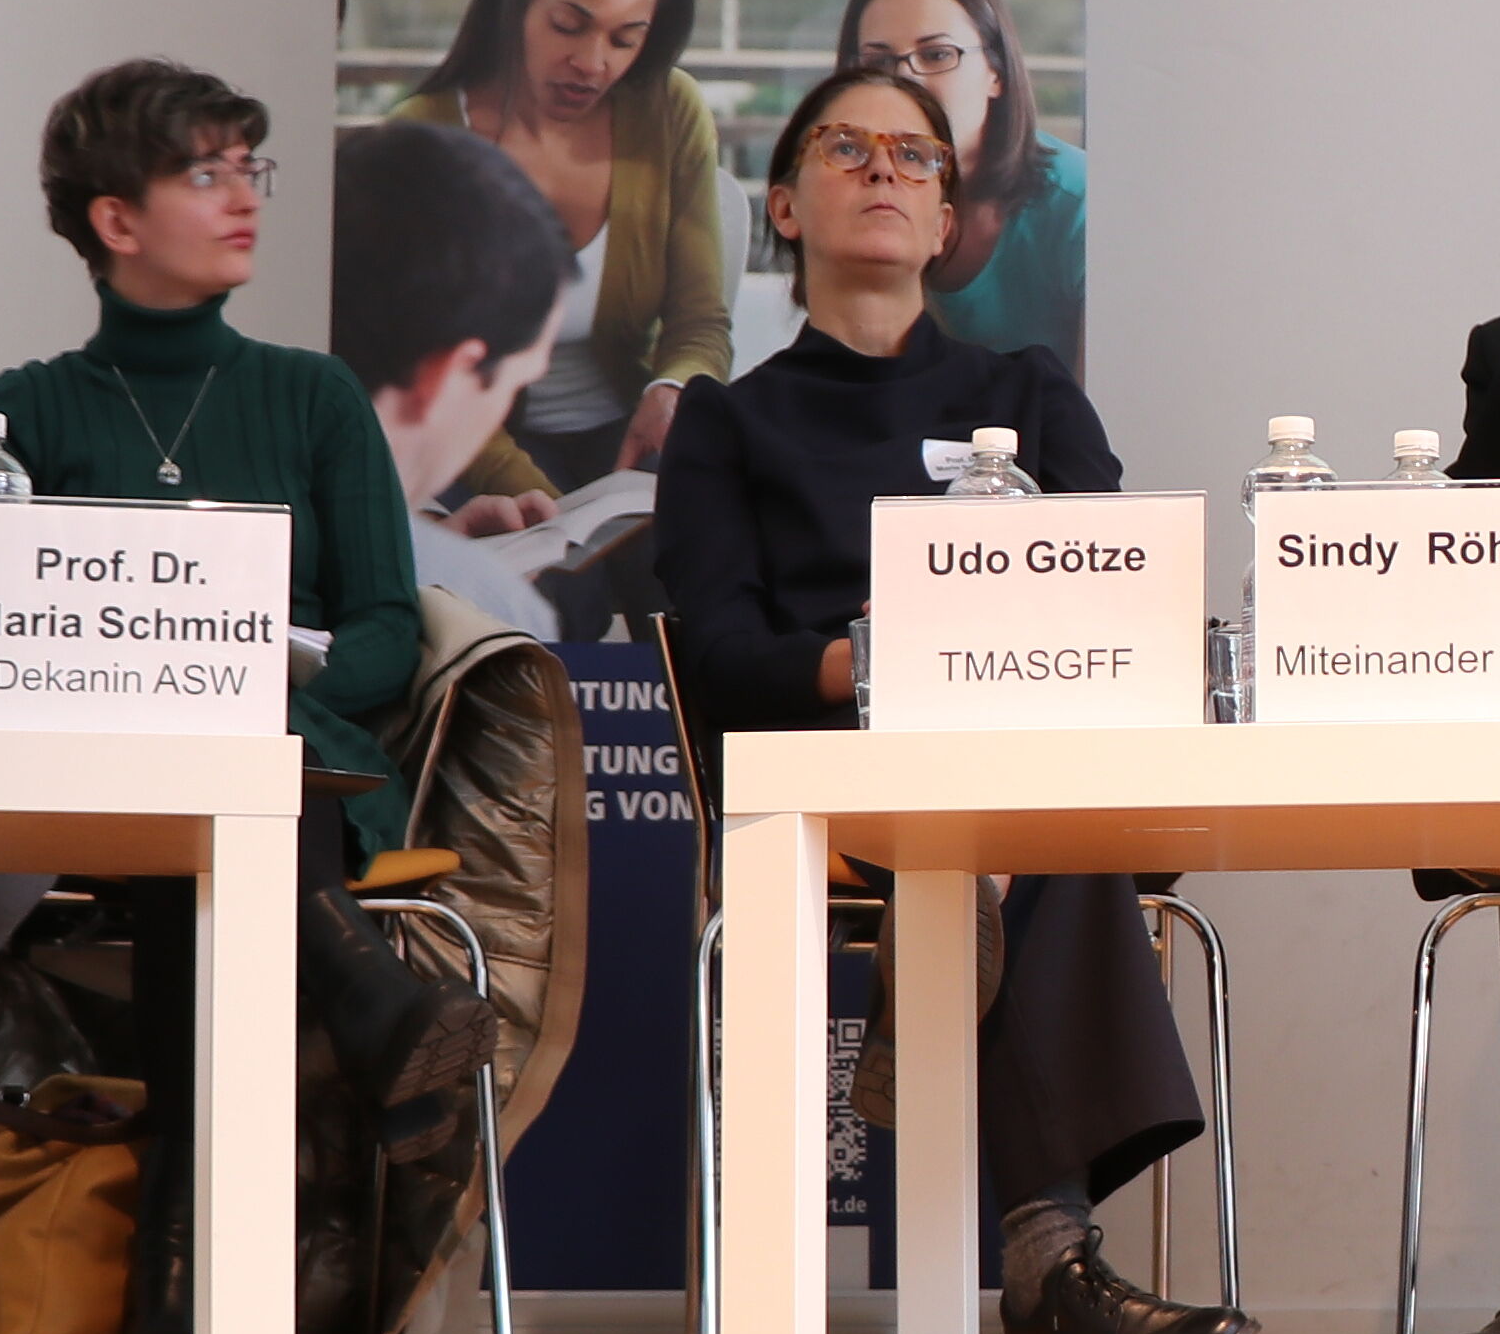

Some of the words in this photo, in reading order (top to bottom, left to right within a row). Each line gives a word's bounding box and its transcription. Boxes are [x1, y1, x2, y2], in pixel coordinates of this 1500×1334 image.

[37, 548, 133, 582] Prof.
[152, 552, 205, 584] Dr.
[929, 543, 1009, 575] Udo
[1026, 541, 1145, 573] Götze
[1279, 533, 1397, 575] Sindy
[99, 606, 272, 643] Schmidt
[939, 648, 1132, 681] TMASGFF
[1276, 643, 1494, 676] Miteinander
[153, 664, 246, 695] ASW
